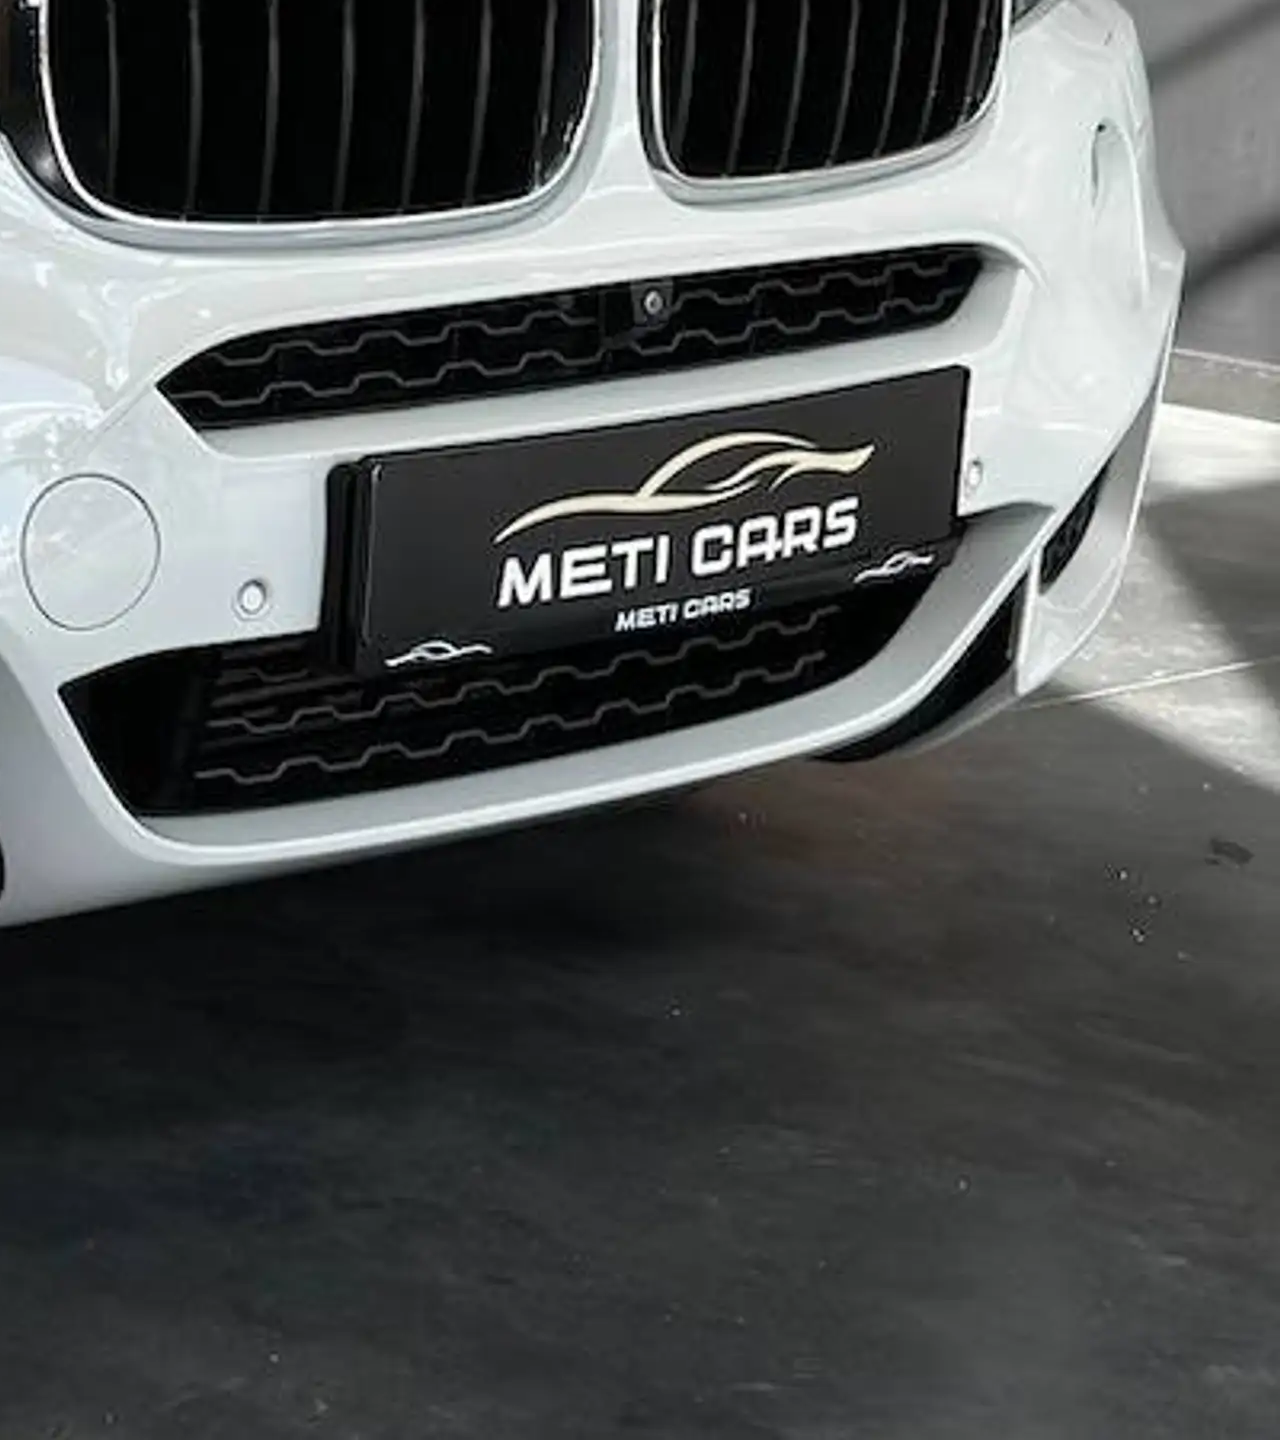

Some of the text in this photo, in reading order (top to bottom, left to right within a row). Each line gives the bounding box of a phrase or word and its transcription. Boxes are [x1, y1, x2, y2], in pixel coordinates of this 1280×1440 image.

[498, 497, 859, 607] METI CARS
[615, 589, 751, 632] METI CARS
